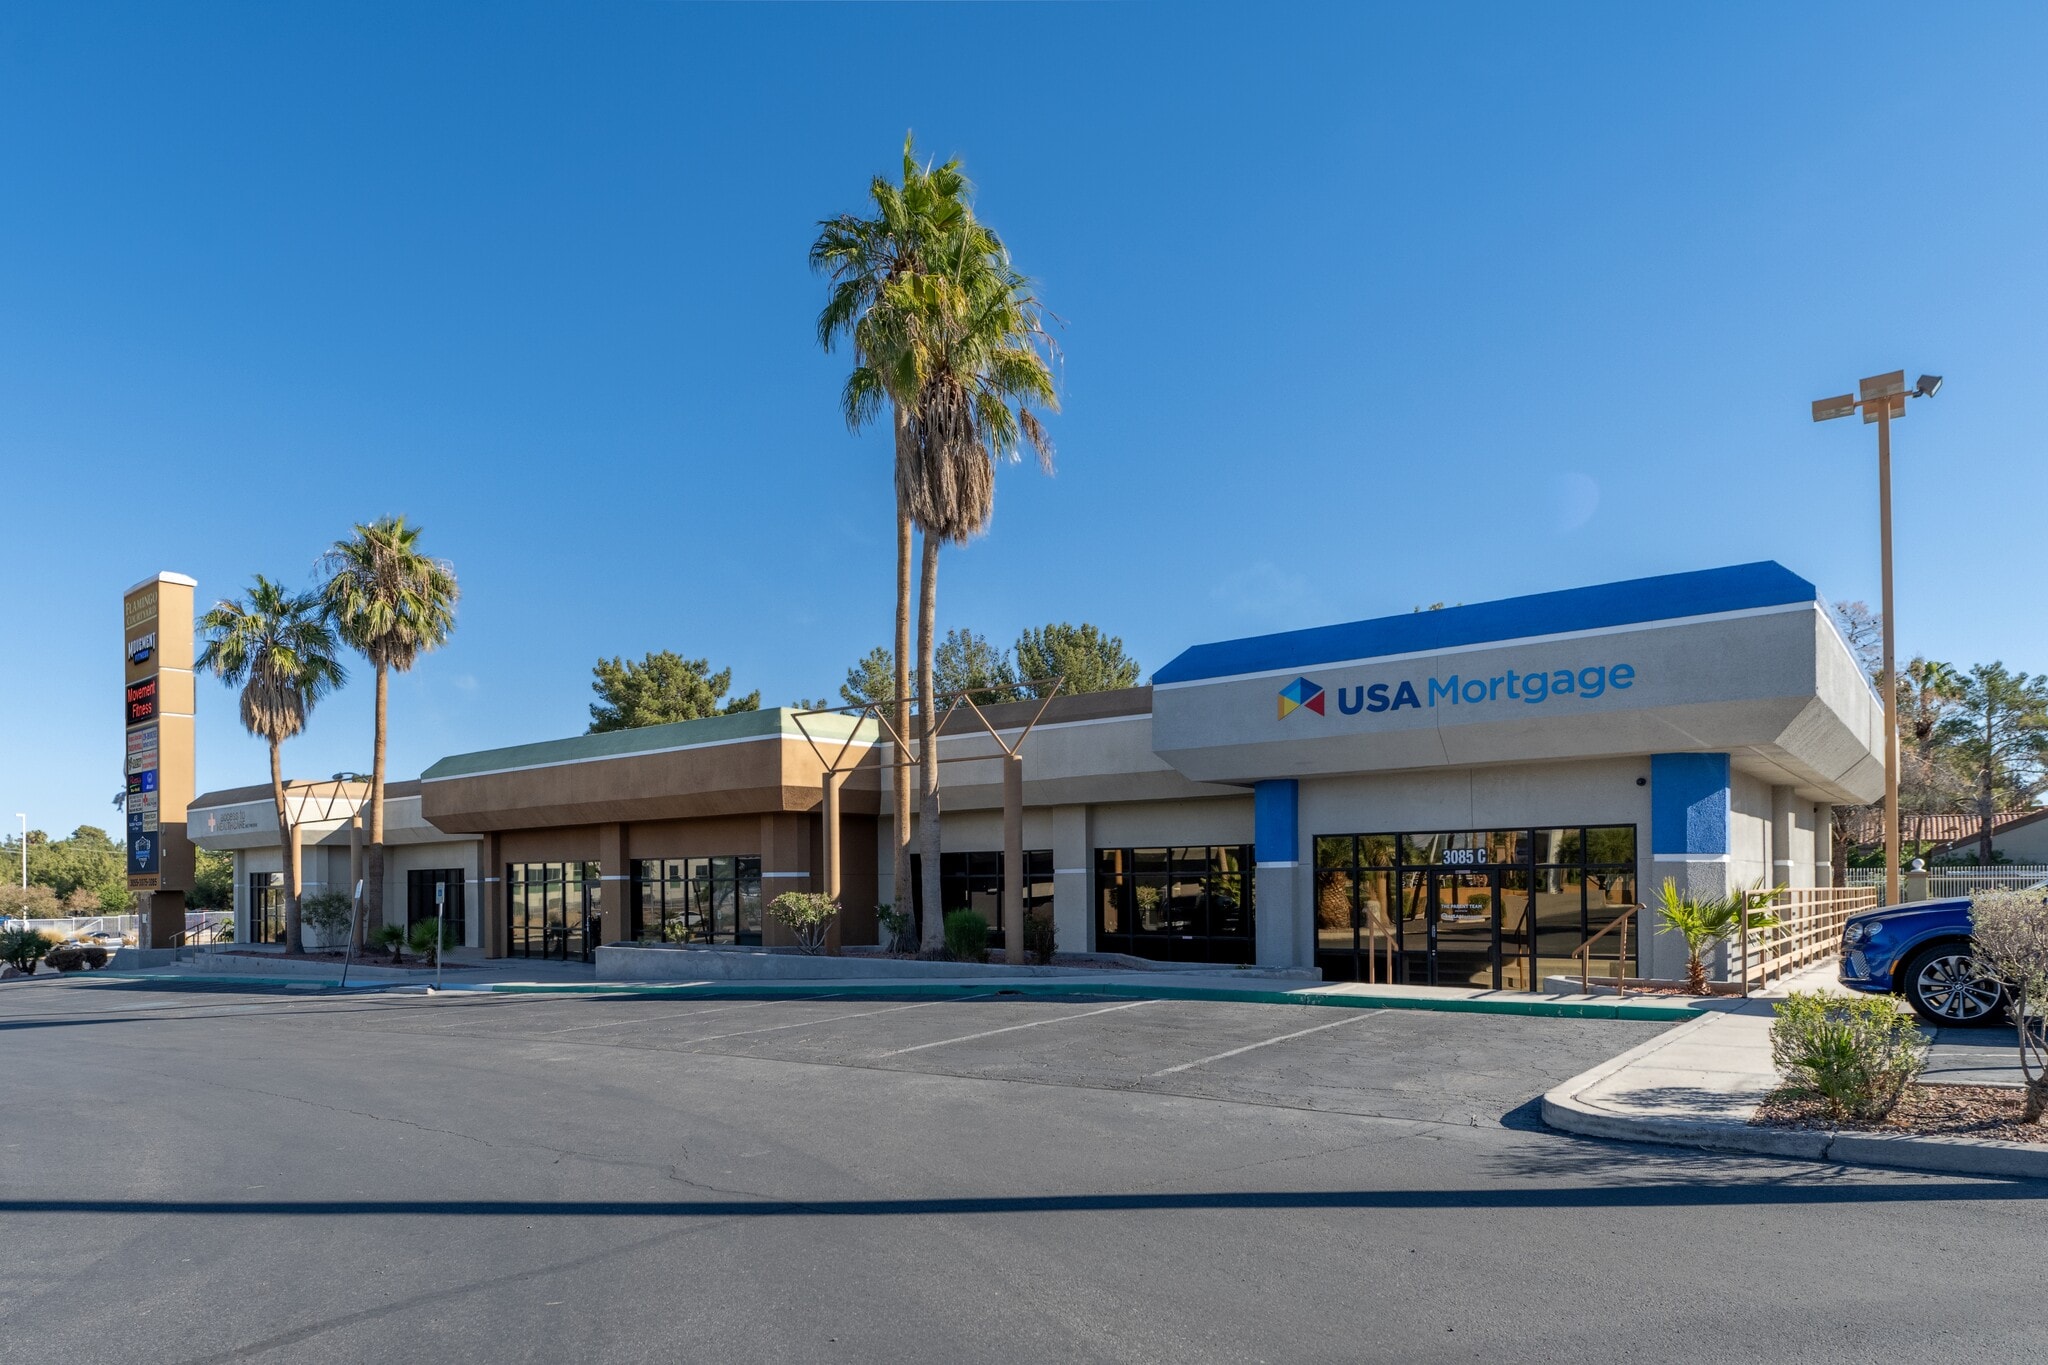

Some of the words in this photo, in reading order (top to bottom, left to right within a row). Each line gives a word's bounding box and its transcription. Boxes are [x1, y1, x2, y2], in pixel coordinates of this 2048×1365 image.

[125, 591, 158, 616] FLAMINGO
[128, 632, 156, 660] MOVEMENT
[127, 680, 156, 703] Movement
[1337, 680, 1421, 715] USA
[1428, 663, 1635, 707] Mortgage
[132, 702, 152, 718] Fitness
[1443, 850, 1473, 864] 3085
[1478, 849, 1486, 864] C
